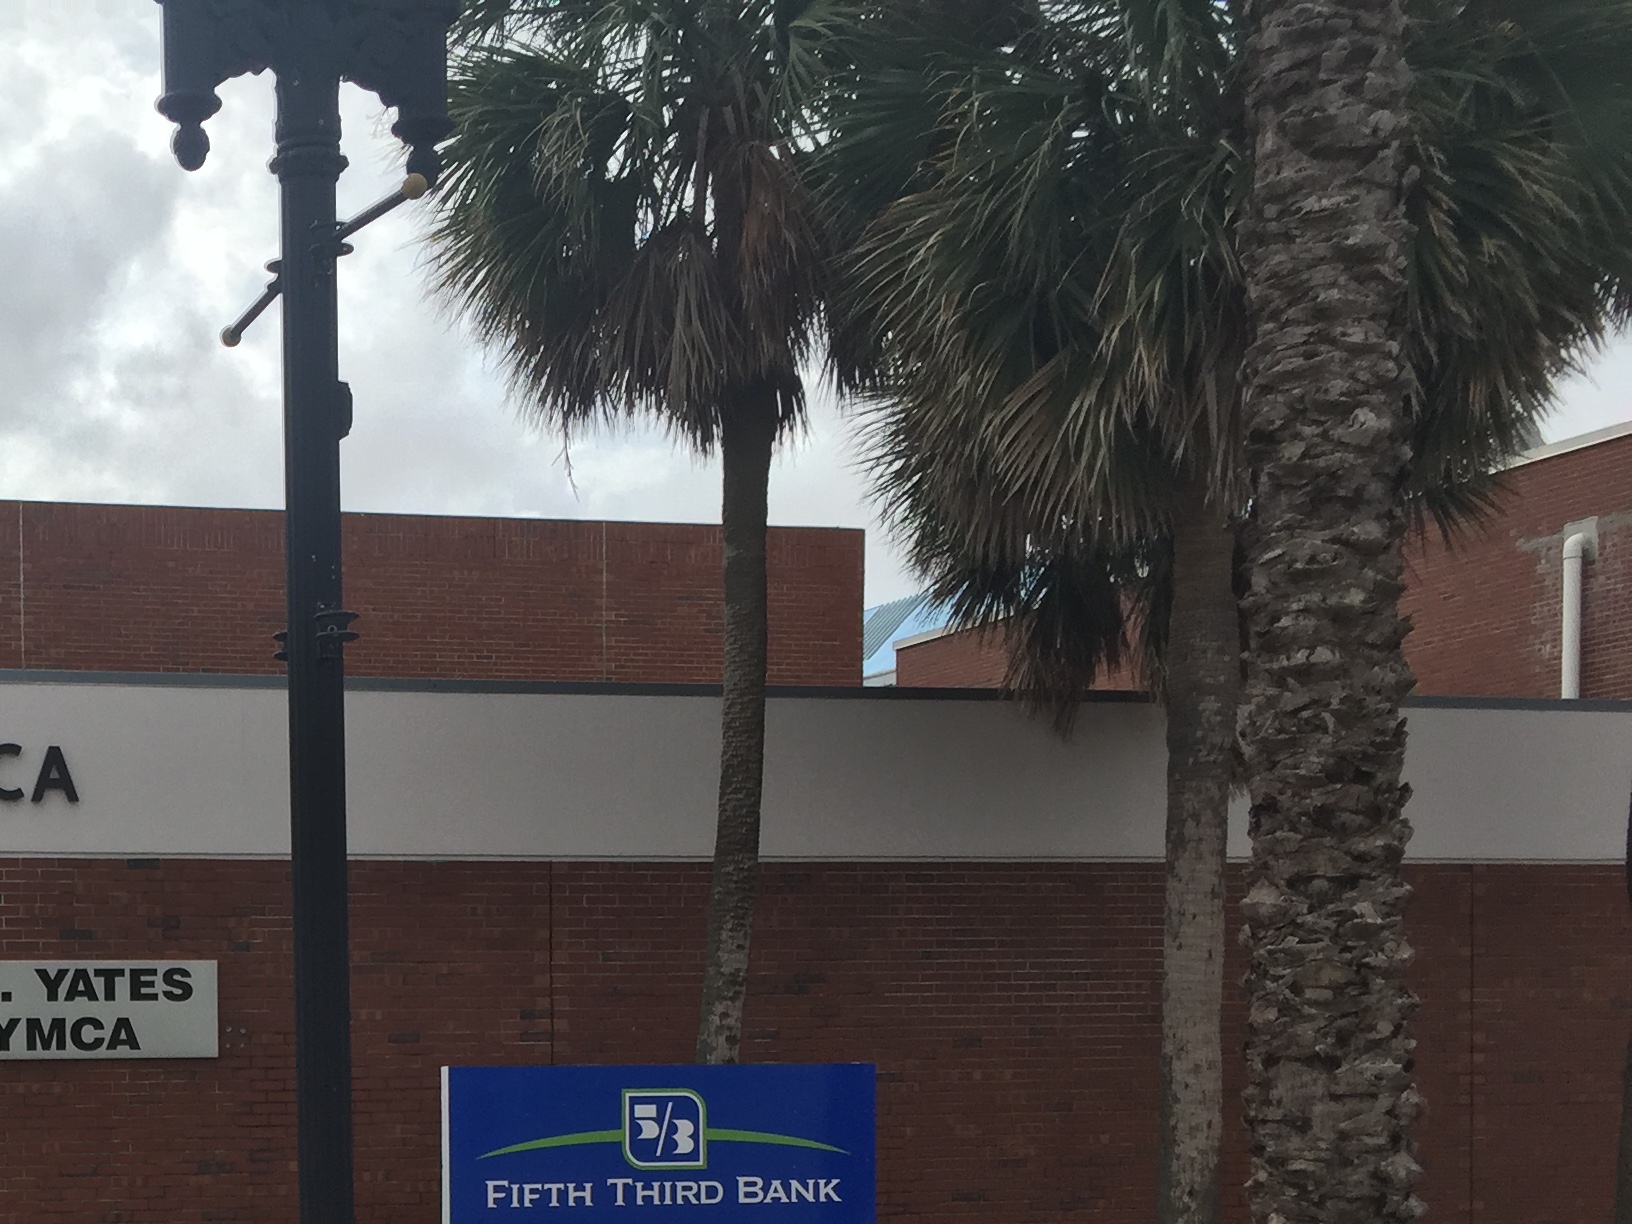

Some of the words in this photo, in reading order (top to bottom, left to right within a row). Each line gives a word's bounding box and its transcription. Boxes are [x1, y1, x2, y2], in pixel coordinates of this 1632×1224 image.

[35, 967, 194, 1002] YATES
[485, 1179, 594, 1208] FIFTH
[606, 1177, 724, 1206] THIRD
[735, 1175, 843, 1204] BANK
